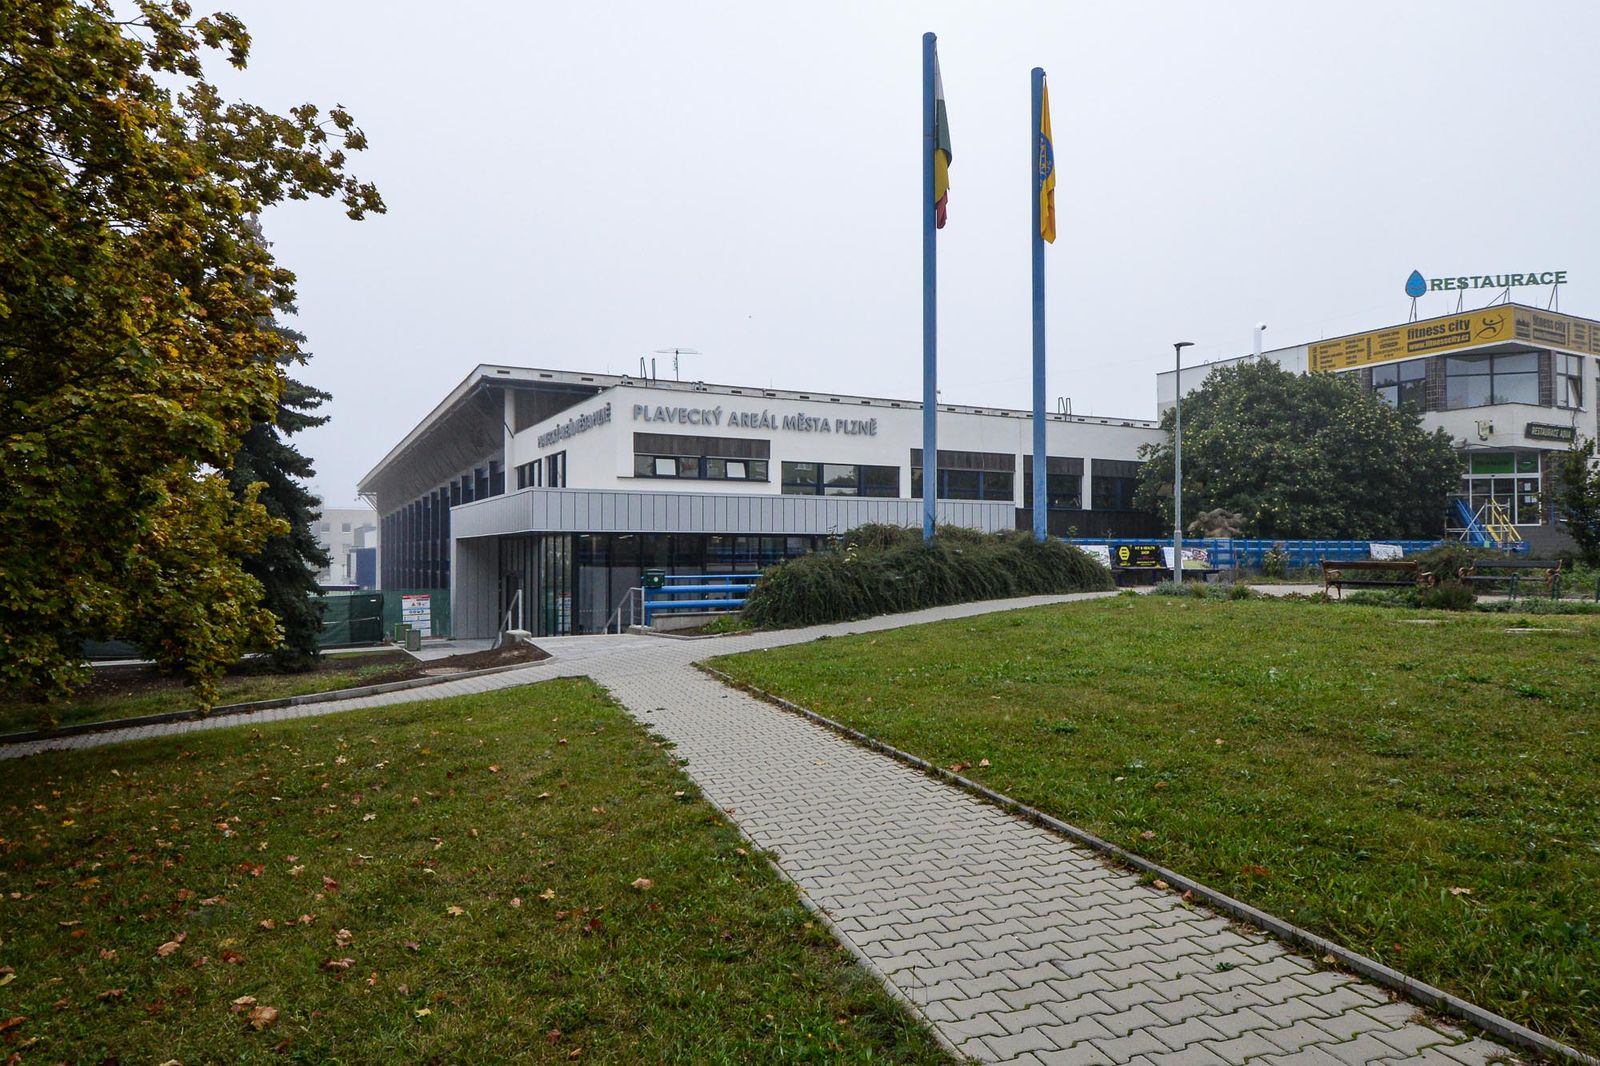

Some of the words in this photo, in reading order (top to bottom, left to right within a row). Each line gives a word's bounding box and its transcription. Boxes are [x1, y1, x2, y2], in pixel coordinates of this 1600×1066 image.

[1430, 270, 1568, 292] RESTAURACE
[1407, 323, 1446, 340] fitness
[1448, 318, 1470, 333] city
[632, 404, 723, 426] PLAVECKÝ
[727, 409, 778, 431] AREÁL
[782, 412, 832, 433] MĚSTA
[835, 417, 878, 437] PLZNĚ
